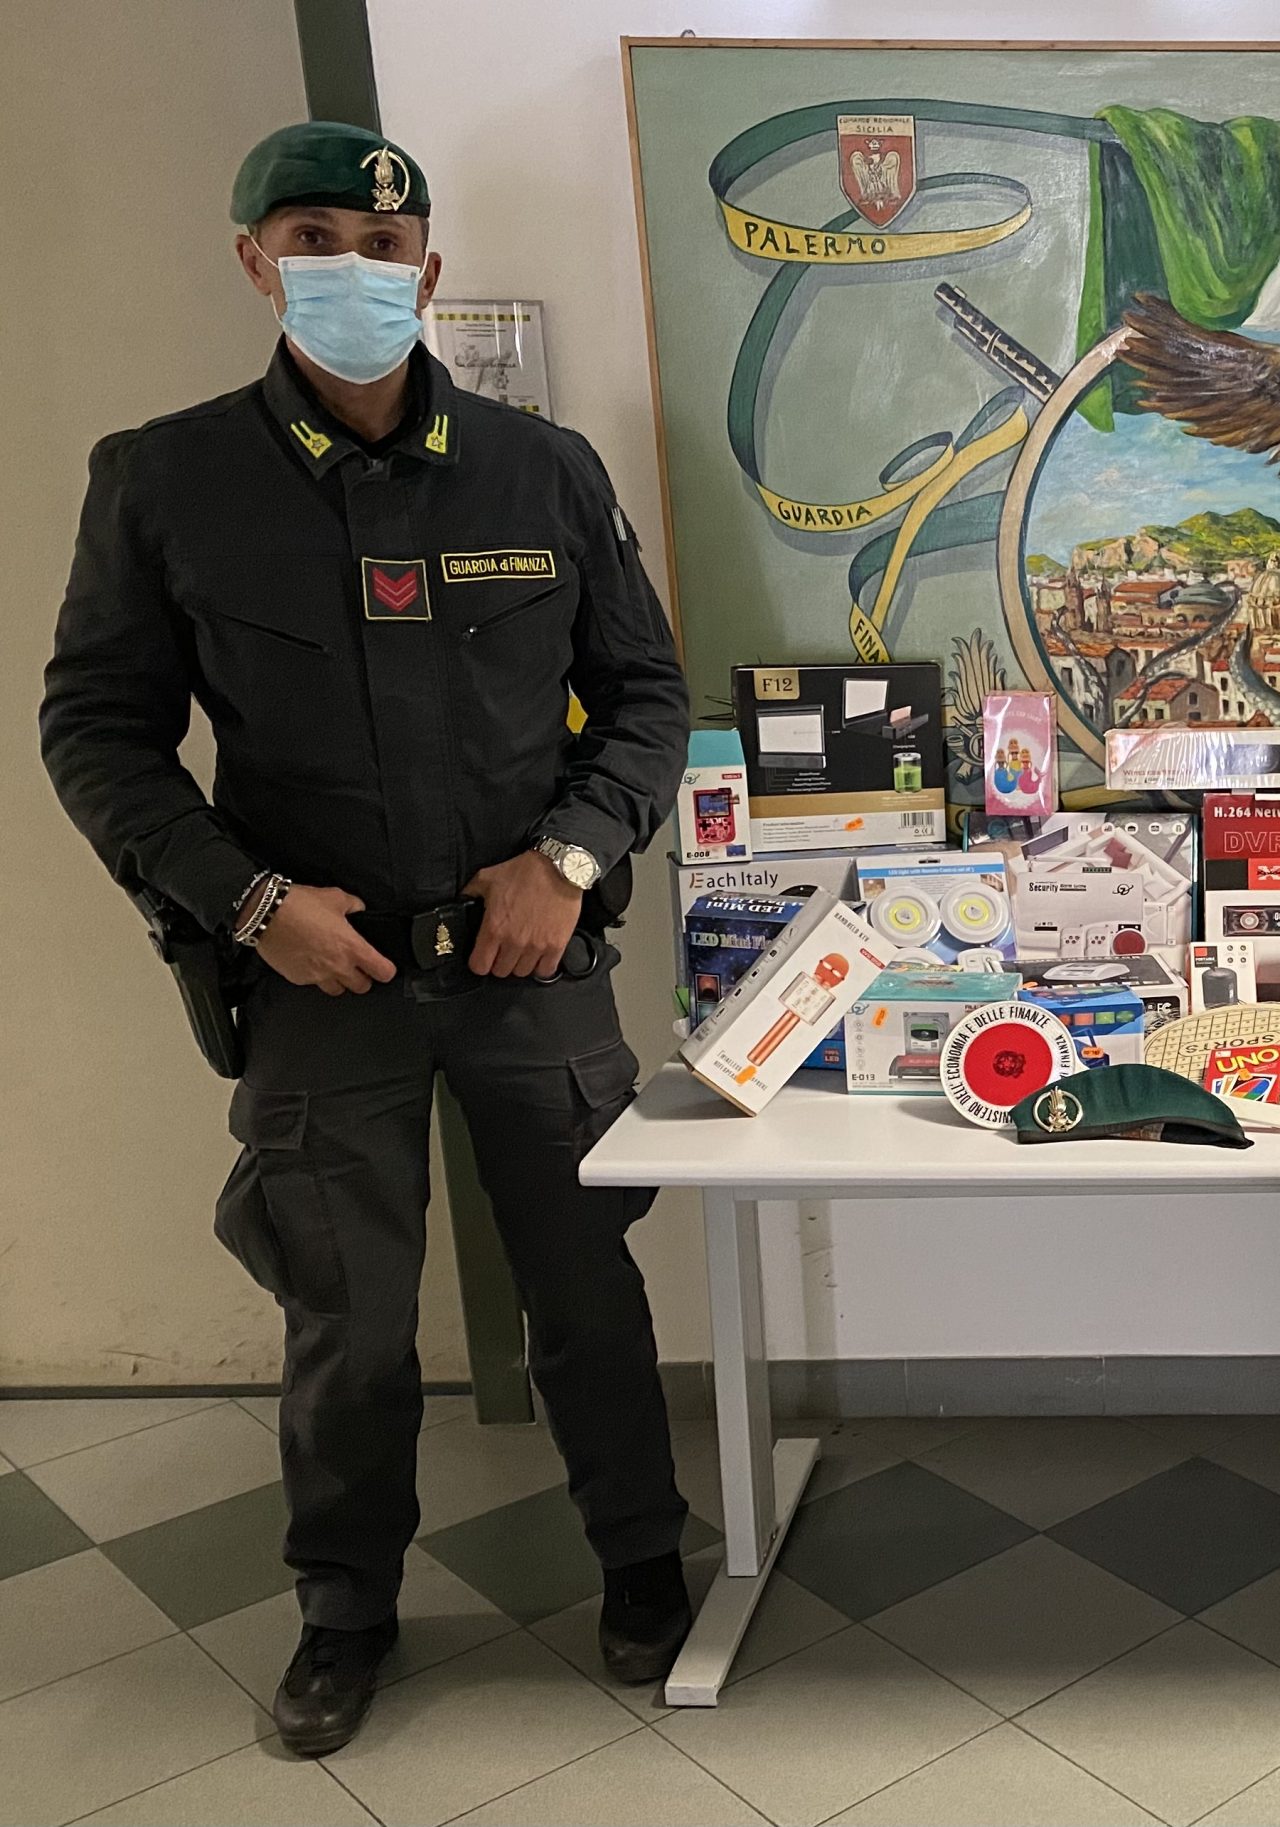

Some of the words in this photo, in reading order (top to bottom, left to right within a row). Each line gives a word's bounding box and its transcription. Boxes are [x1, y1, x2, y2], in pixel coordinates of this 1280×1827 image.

[745, 221, 886, 256] PALERMO
[777, 501, 873, 526] GUARDIA
[449, 557, 498, 575] GUARDIA
[500, 559, 509, 571] di
[509, 556, 550, 571] FINANZA
[854, 618, 884, 662] FINA
[762, 678, 793, 692] F12
[1214, 806, 1251, 818] H.264
[689, 872, 736, 888] Each
[741, 870, 779, 888] Italy
[1029, 882, 1059, 893] Security
[705, 900, 745, 912] Mini
[749, 905, 785, 914] LED
[966, 1023, 976, 1035] E
[973, 1006, 1006, 1028] DELLE
[1009, 1006, 1051, 1029] FINANZE
[1055, 1034, 1072, 1069] FINANZA
[1185, 1034, 1275, 1054] SPORTS
[1215, 1048, 1280, 1073] UNO
[851, 1073, 876, 1081] E-013
